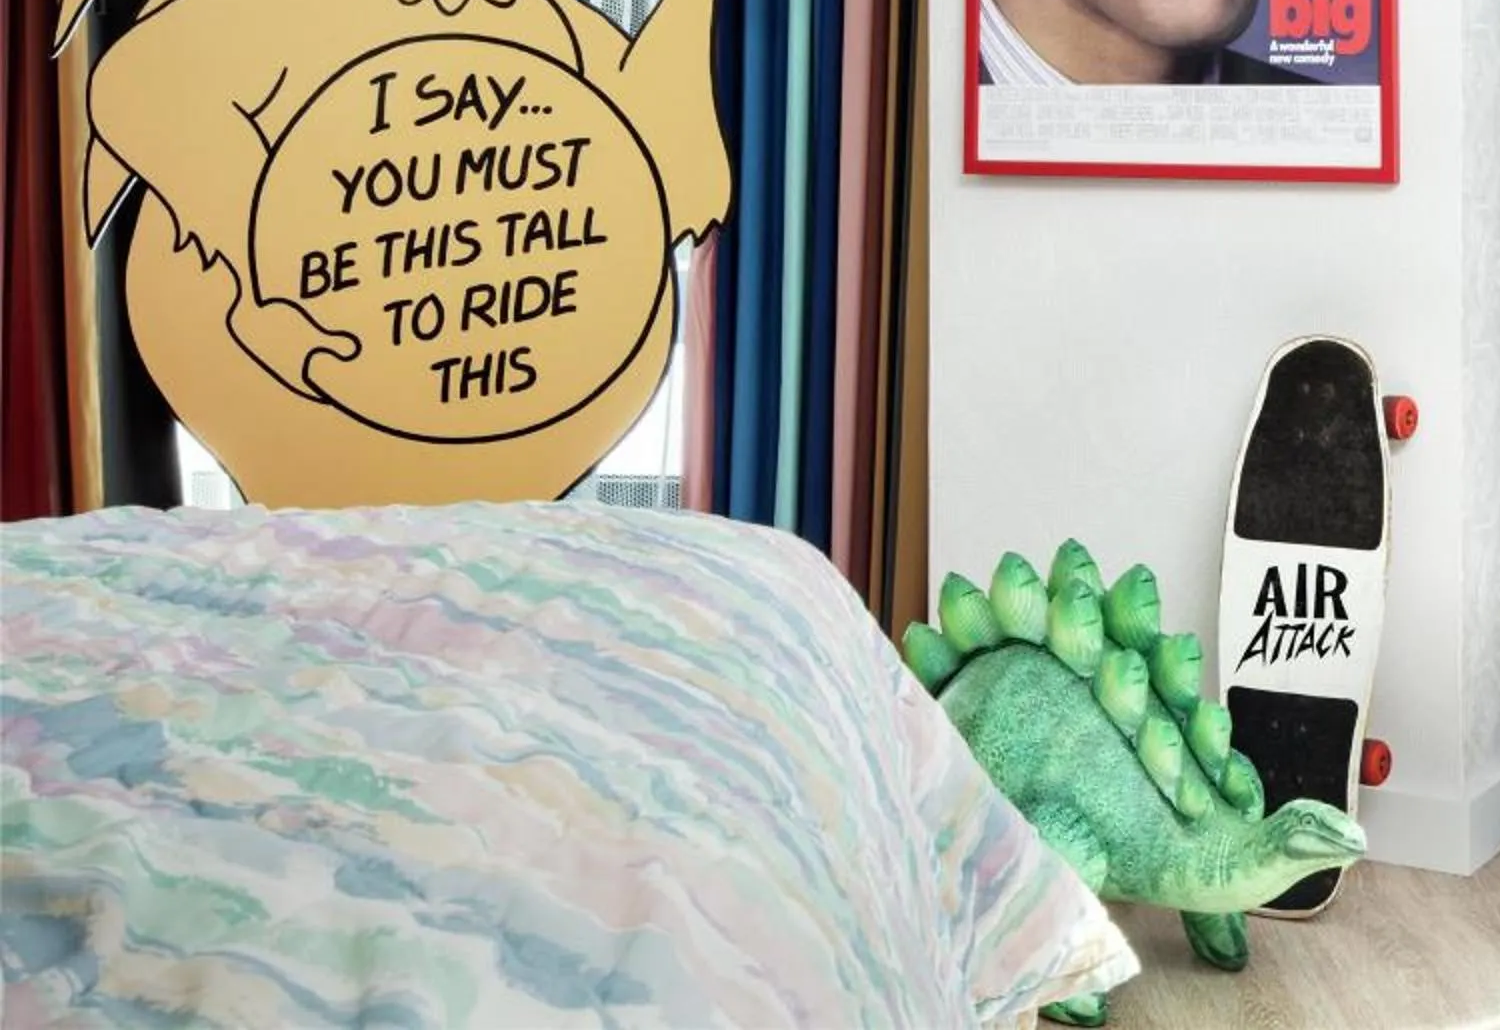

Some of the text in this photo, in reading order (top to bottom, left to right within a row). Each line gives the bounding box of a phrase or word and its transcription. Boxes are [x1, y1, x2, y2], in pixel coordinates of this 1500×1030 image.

[369, 71, 553, 134] I SAY...
[331, 137, 591, 214] YOU MUST
[299, 206, 608, 299] BE THIS TALL
[383, 269, 579, 346] TO RIDE
[430, 346, 538, 403] THIS
[1253, 563, 1349, 621] AIR
[1234, 610, 1356, 674] ATTACK
